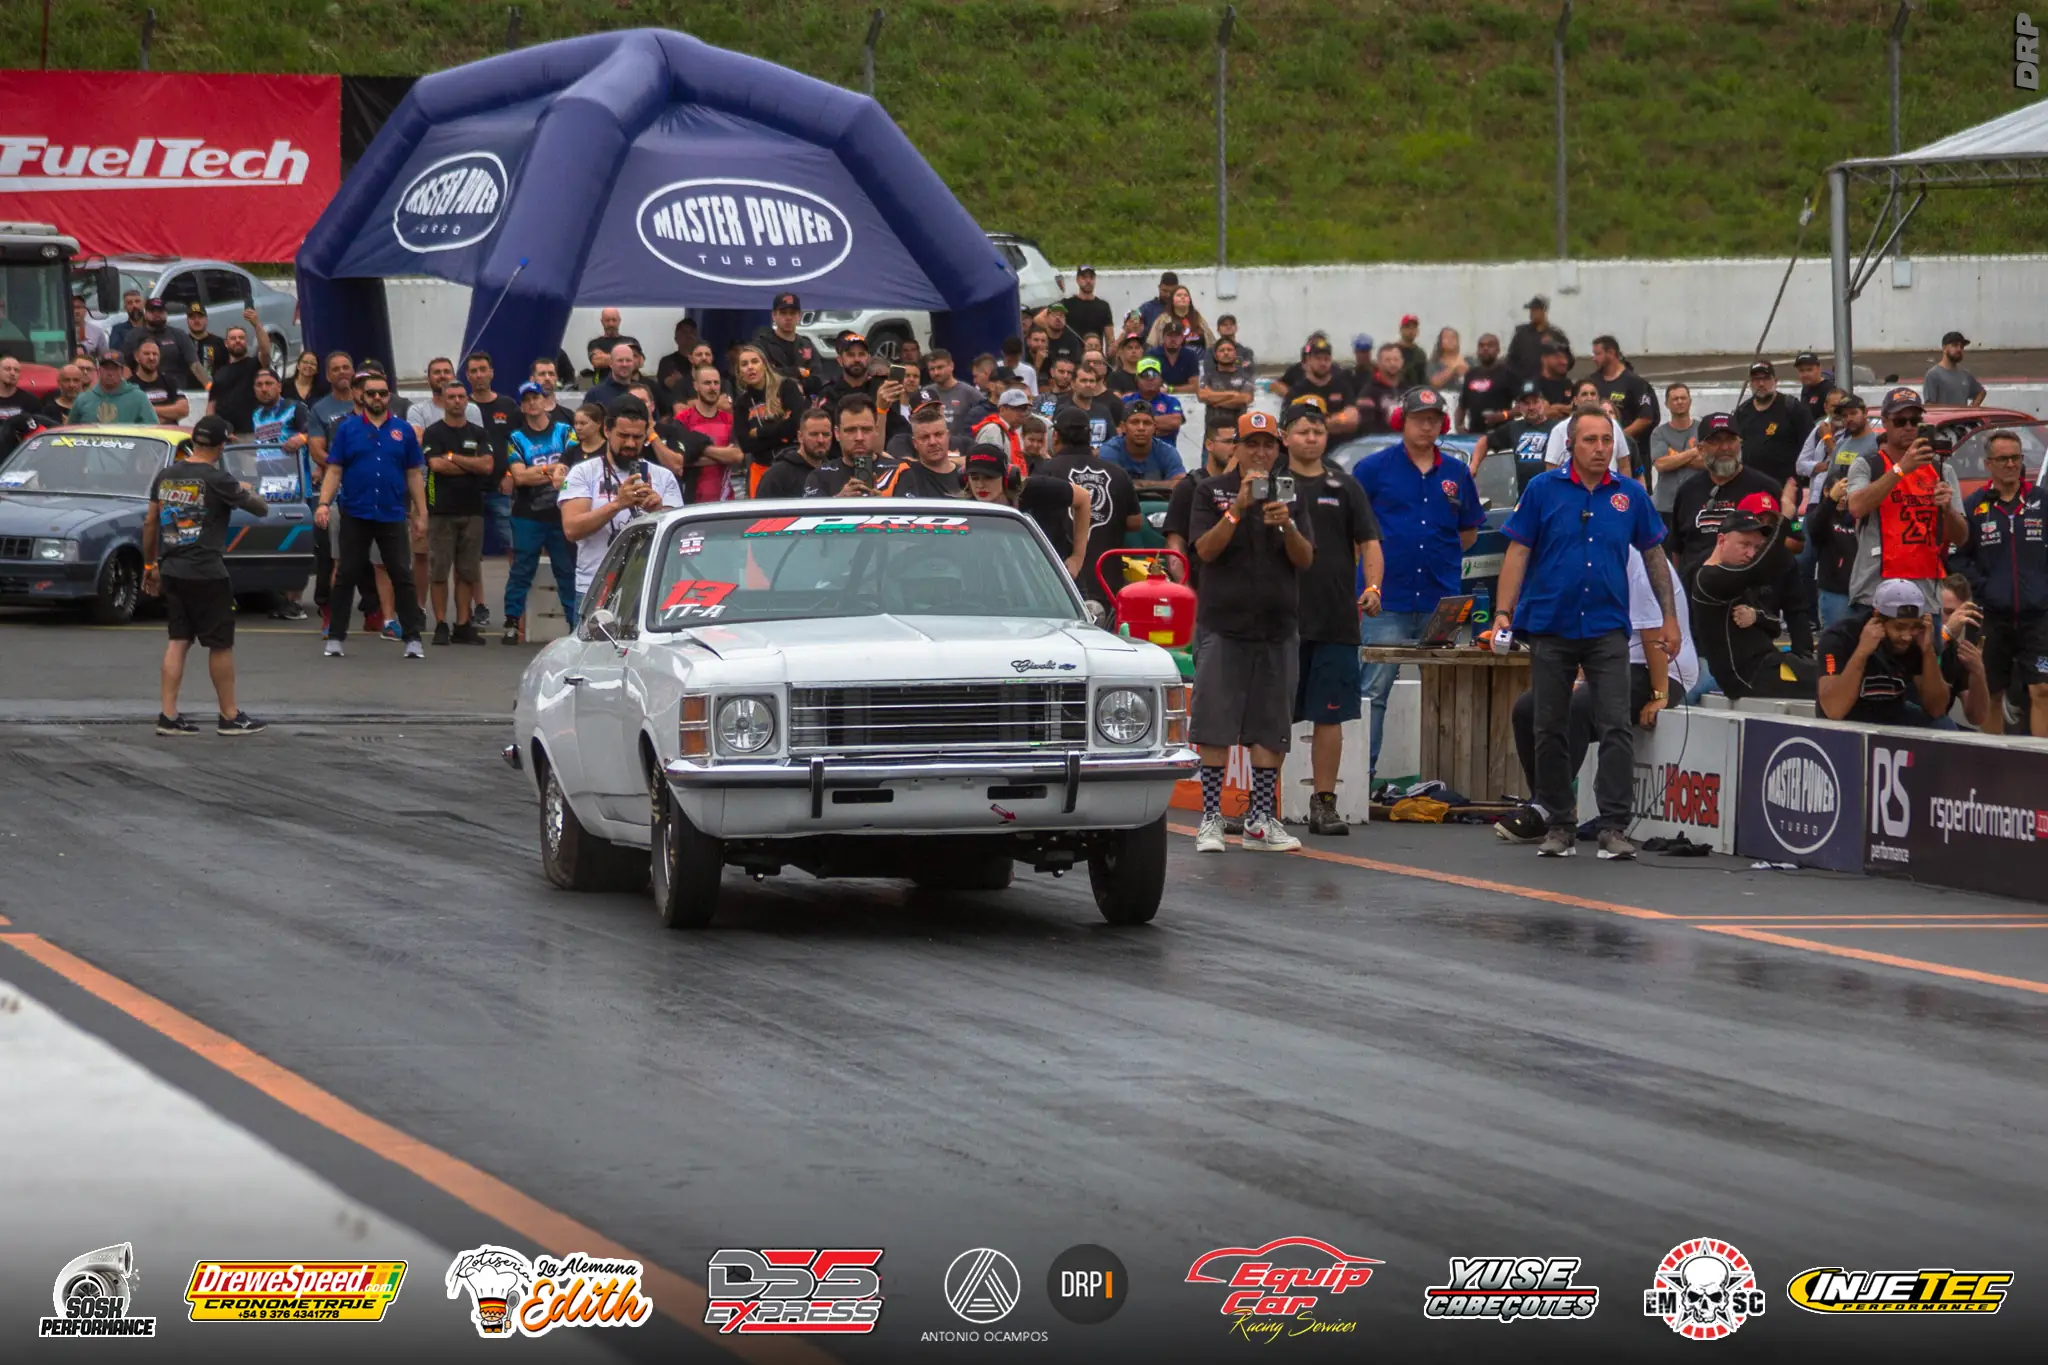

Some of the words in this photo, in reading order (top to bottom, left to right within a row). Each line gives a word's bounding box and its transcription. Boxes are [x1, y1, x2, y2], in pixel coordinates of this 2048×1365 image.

[0, 136, 310, 185] FuelTech
[653, 195, 746, 247] MASTER
[744, 196, 833, 247] POWER
[698, 254, 802, 267] TURBO
[783, 514, 968, 531] PRO
[660, 579, 739, 611] 13
[664, 603, 727, 620] TT-A
[1871, 747, 1915, 838] RS
